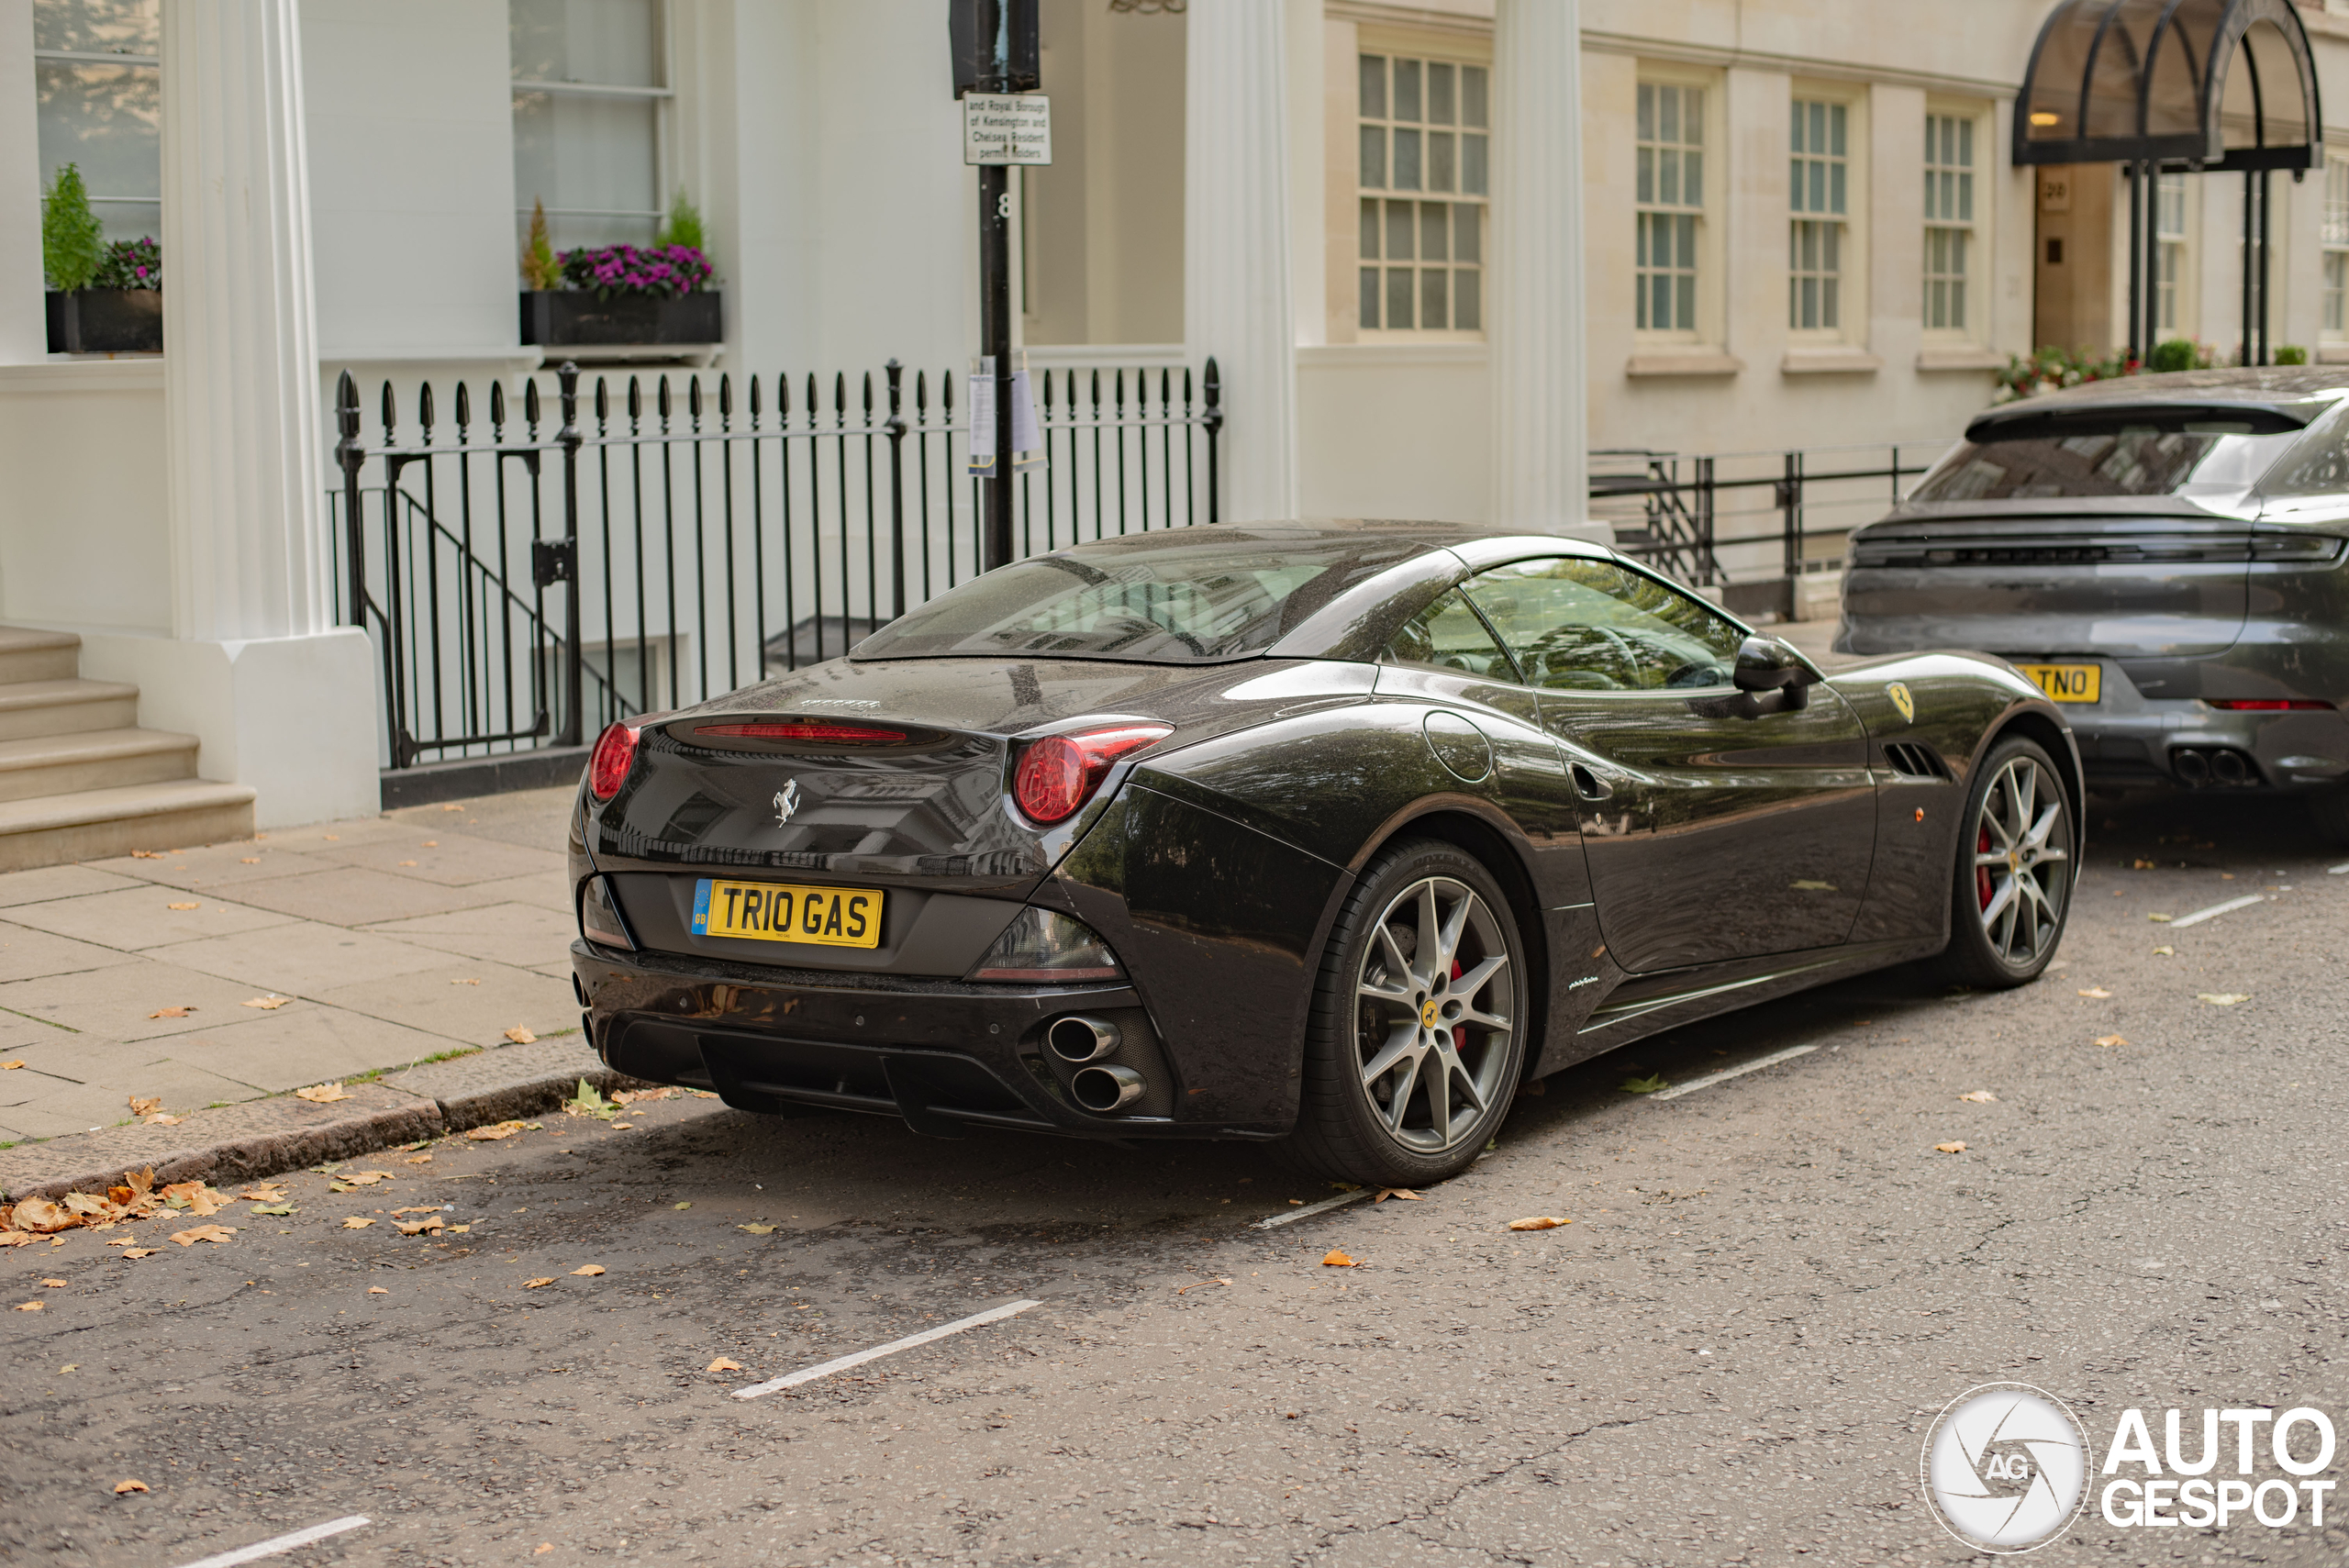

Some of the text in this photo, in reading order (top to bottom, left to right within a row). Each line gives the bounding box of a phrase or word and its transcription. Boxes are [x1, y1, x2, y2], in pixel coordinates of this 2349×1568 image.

[969, 100, 1046, 114] and Royal Borough
[970, 116, 1046, 128] of Kensington and
[973, 130, 1045, 143] Chelsea Resident
[980, 146, 1041, 159] permit holders
[998, 193, 1011, 218] 8
[1412, 852, 1480, 877] POTENZA
[695, 913, 707, 925] GB
[802, 893, 869, 938] GAS
